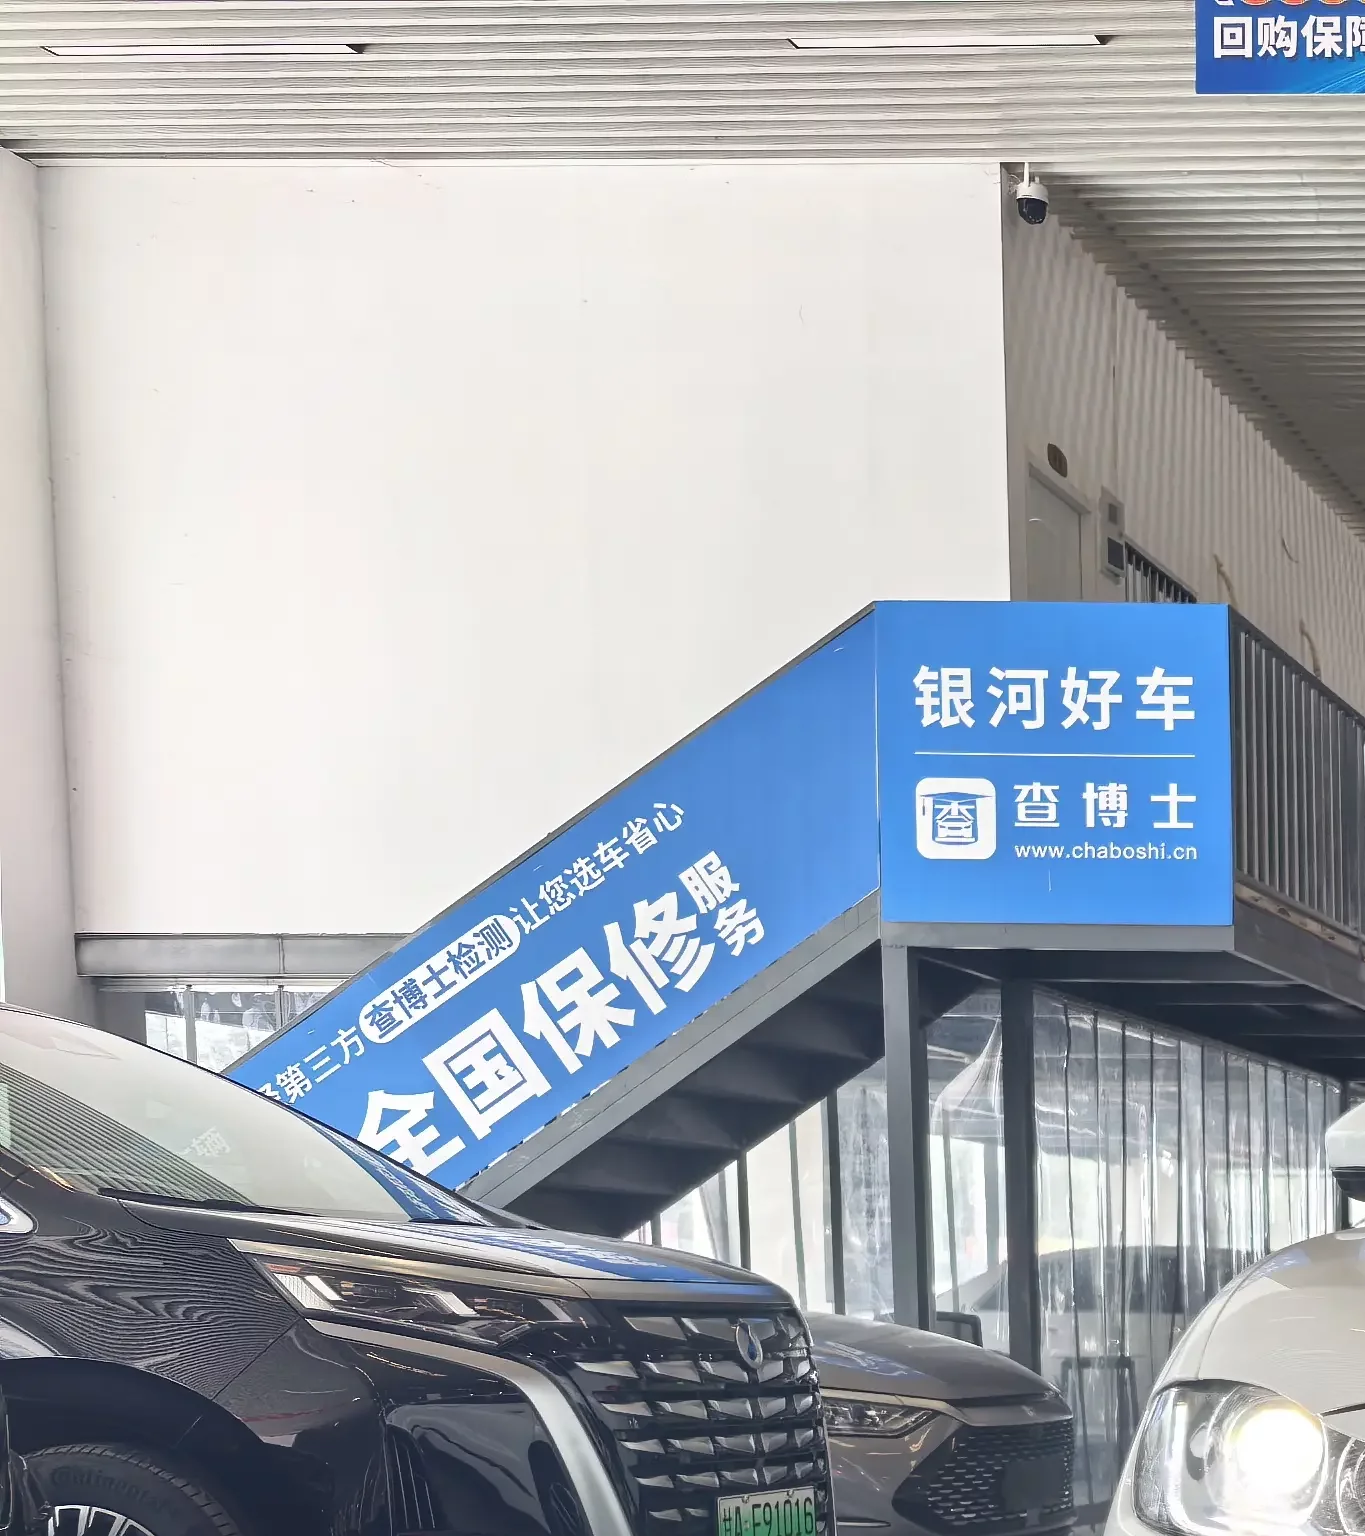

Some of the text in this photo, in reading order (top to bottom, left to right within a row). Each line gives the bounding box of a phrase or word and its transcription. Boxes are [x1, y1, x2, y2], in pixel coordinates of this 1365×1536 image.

[912, 664, 1196, 732] 银河好车
[1013, 781, 1197, 829] 查博士
[1013, 841, 1198, 860] www.chaboshi.cn
[677, 850, 767, 957] 服务
[356, 891, 715, 1175] 全国保修
